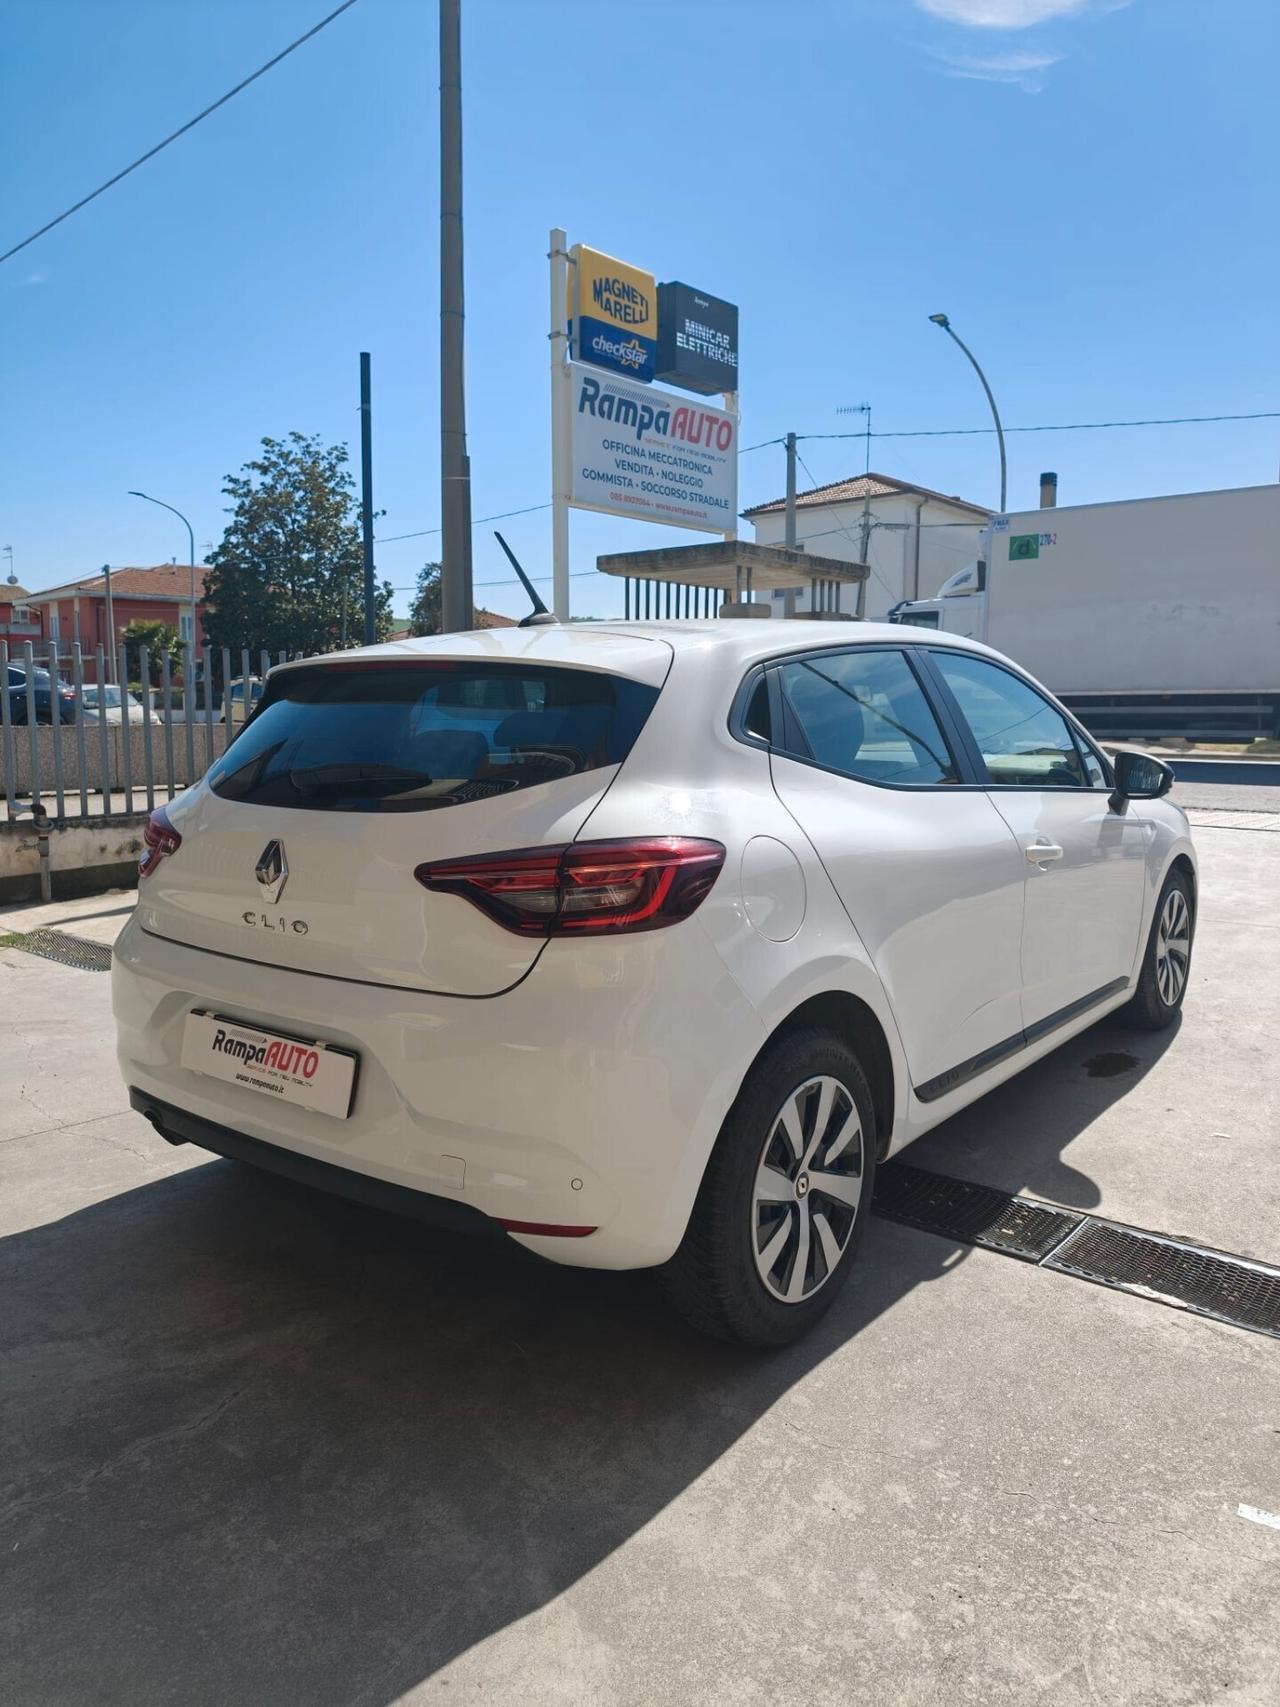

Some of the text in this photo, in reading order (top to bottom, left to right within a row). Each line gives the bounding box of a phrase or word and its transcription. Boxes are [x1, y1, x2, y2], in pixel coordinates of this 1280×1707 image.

[593, 277, 648, 308] MAGNETI
[593, 292, 648, 324] MARELLI
[685, 318, 730, 349] MINICAR
[592, 335, 648, 364] checkstar
[676, 332, 737, 367] ELETTRICHE
[602, 439, 713, 476] OFFICINA MECCATRONICA
[615, 458, 704, 488] VENDITA NOLEGGIO
[582, 468, 729, 509] GOMMISTA SOCCORSO STRADALE
[241, 911, 309, 936] CLIO
